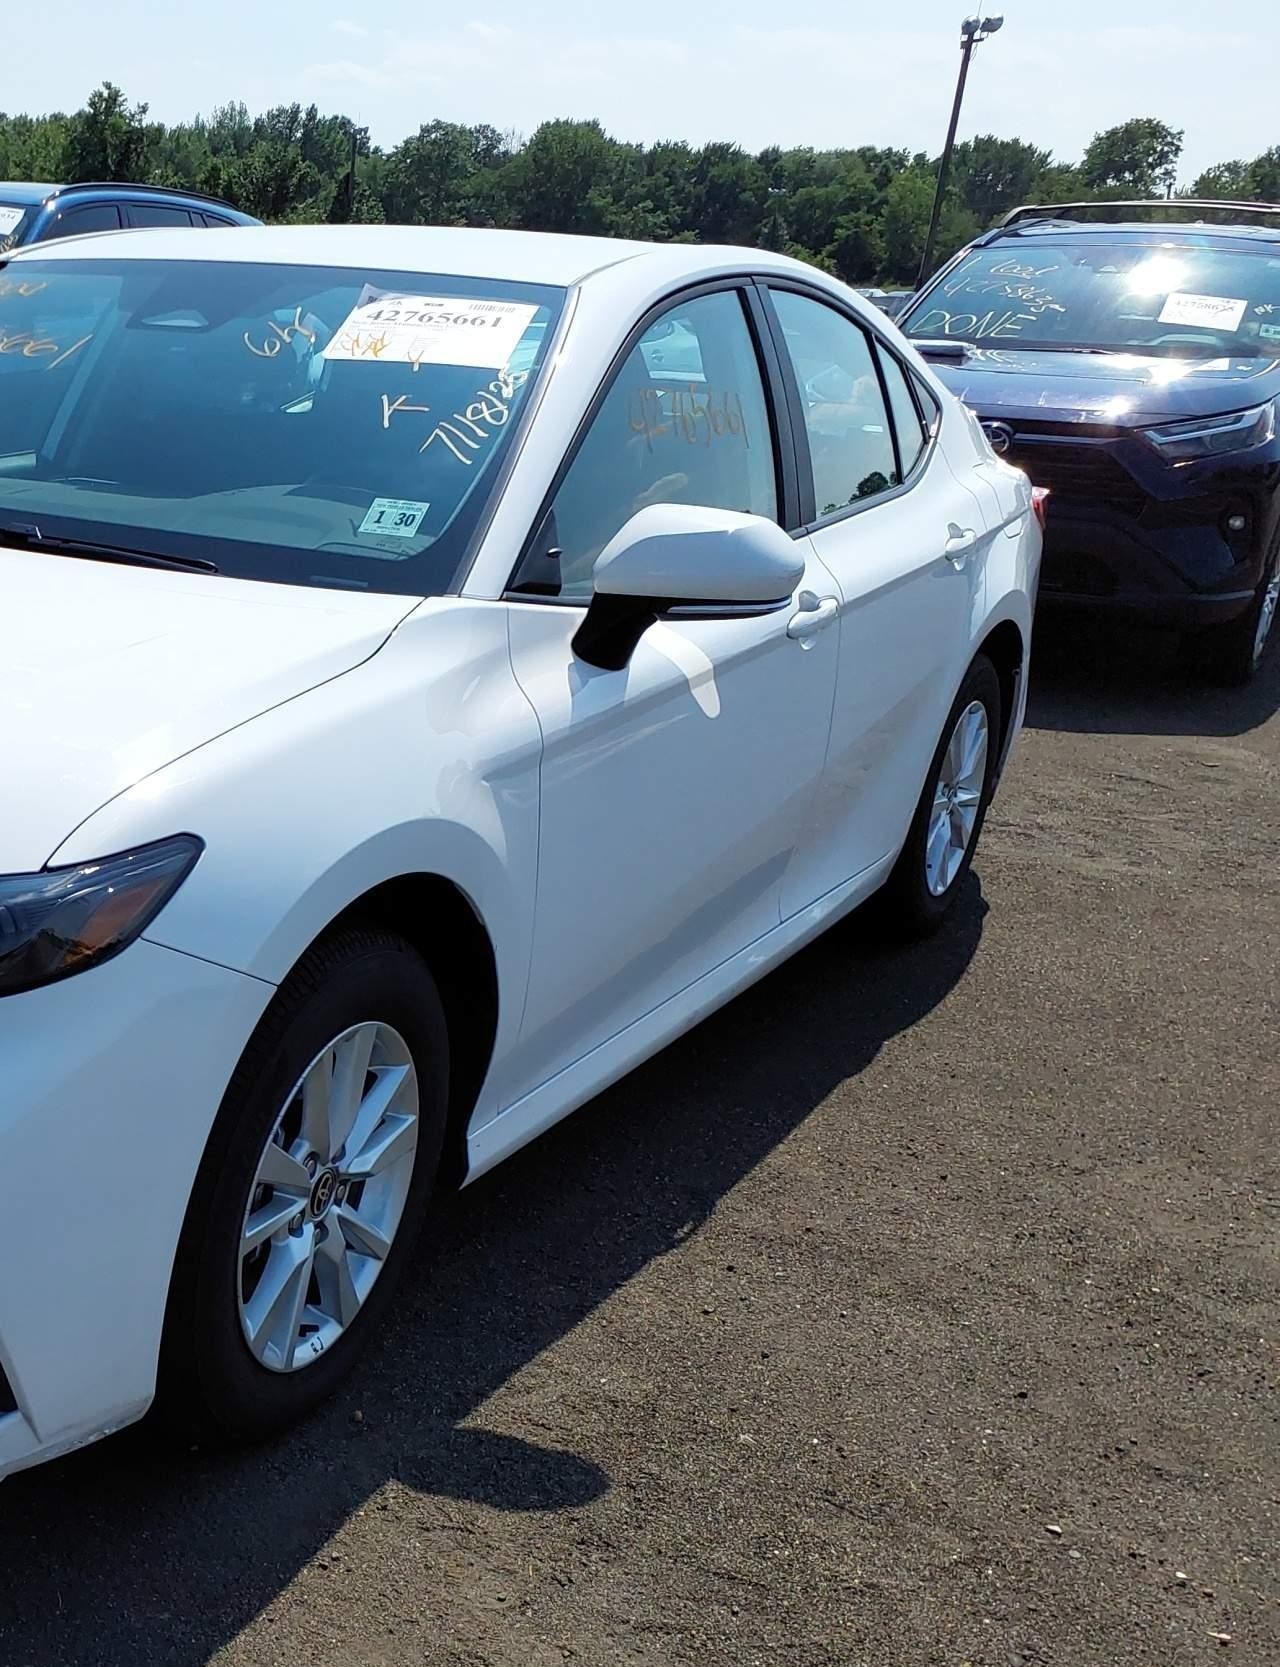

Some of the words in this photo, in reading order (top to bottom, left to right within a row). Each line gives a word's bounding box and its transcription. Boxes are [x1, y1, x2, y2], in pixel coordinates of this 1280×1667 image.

[366, 309, 503, 330] 42765661
[909, 309, 1038, 339] DONE
[380, 393, 431, 430] K
[373, 509, 387, 524] 1
[394, 511, 417, 527] 30
